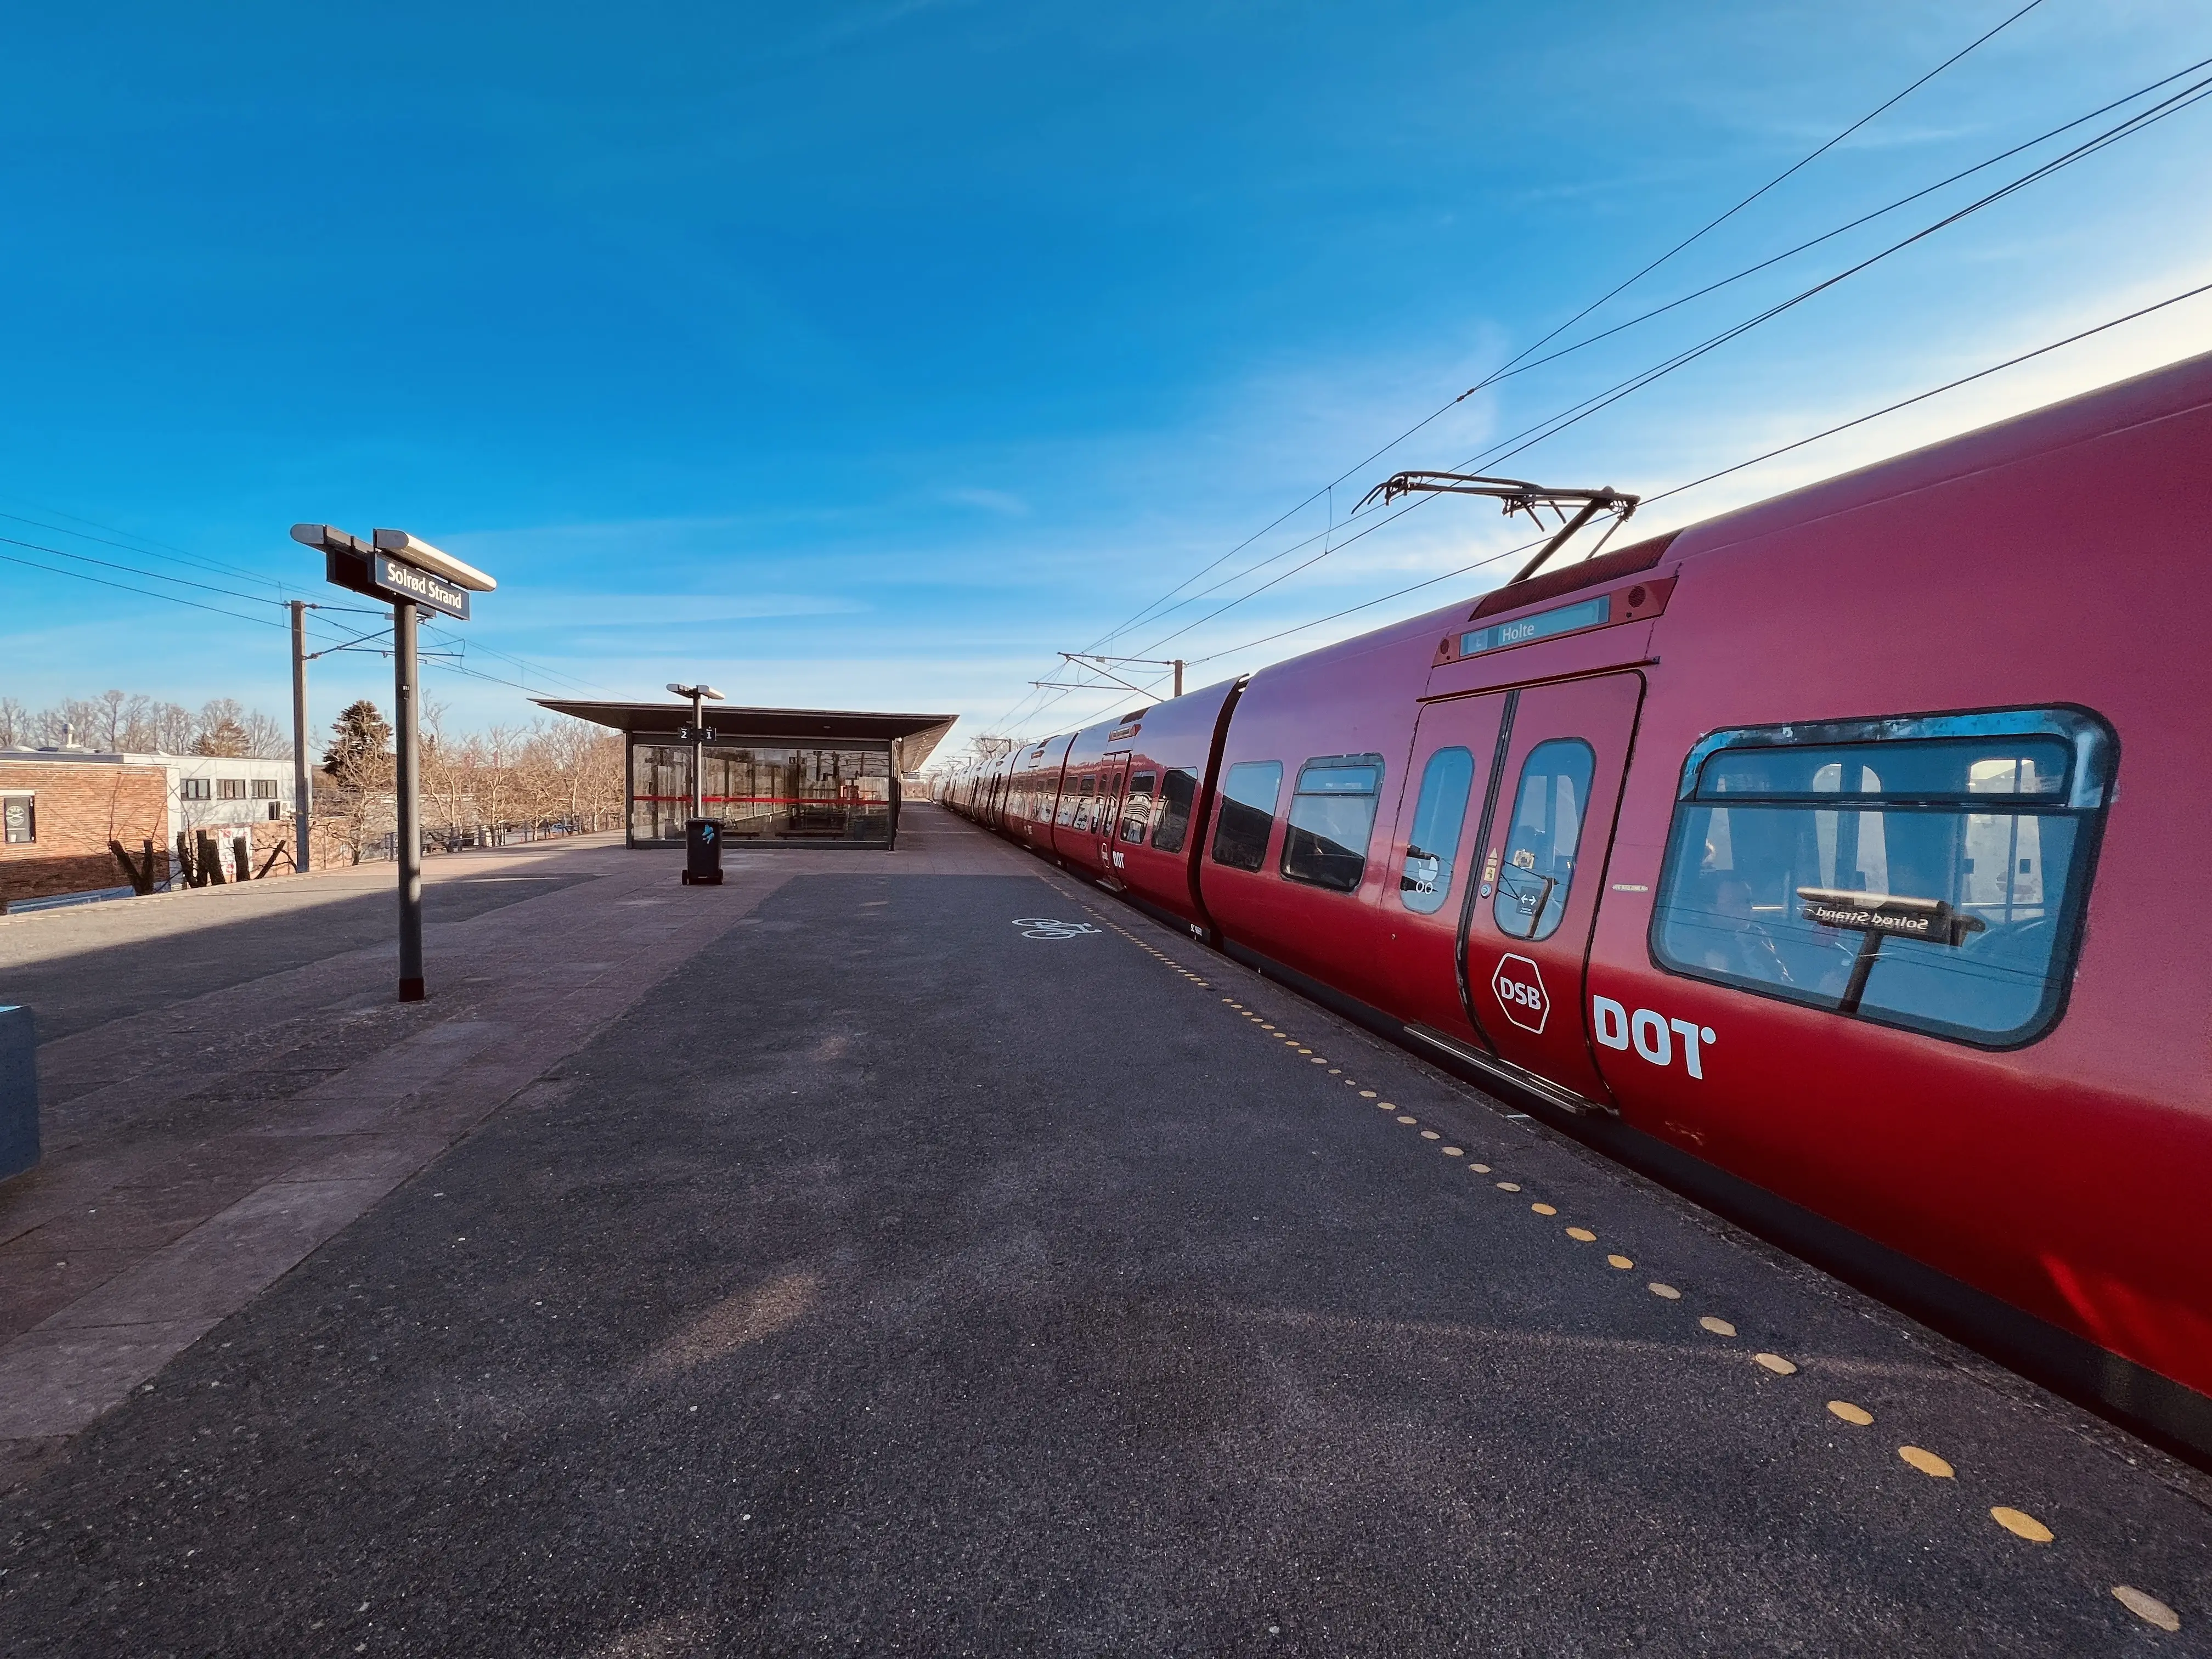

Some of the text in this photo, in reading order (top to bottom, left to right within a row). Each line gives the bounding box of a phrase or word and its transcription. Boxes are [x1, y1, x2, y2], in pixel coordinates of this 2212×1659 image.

[387, 563, 462, 610] Solrød Strand
[1503, 624, 1534, 642] Holte
[681, 731, 687, 739] 2
[1500, 976, 1541, 1010] DSB
[1593, 995, 1703, 1080] DOT
